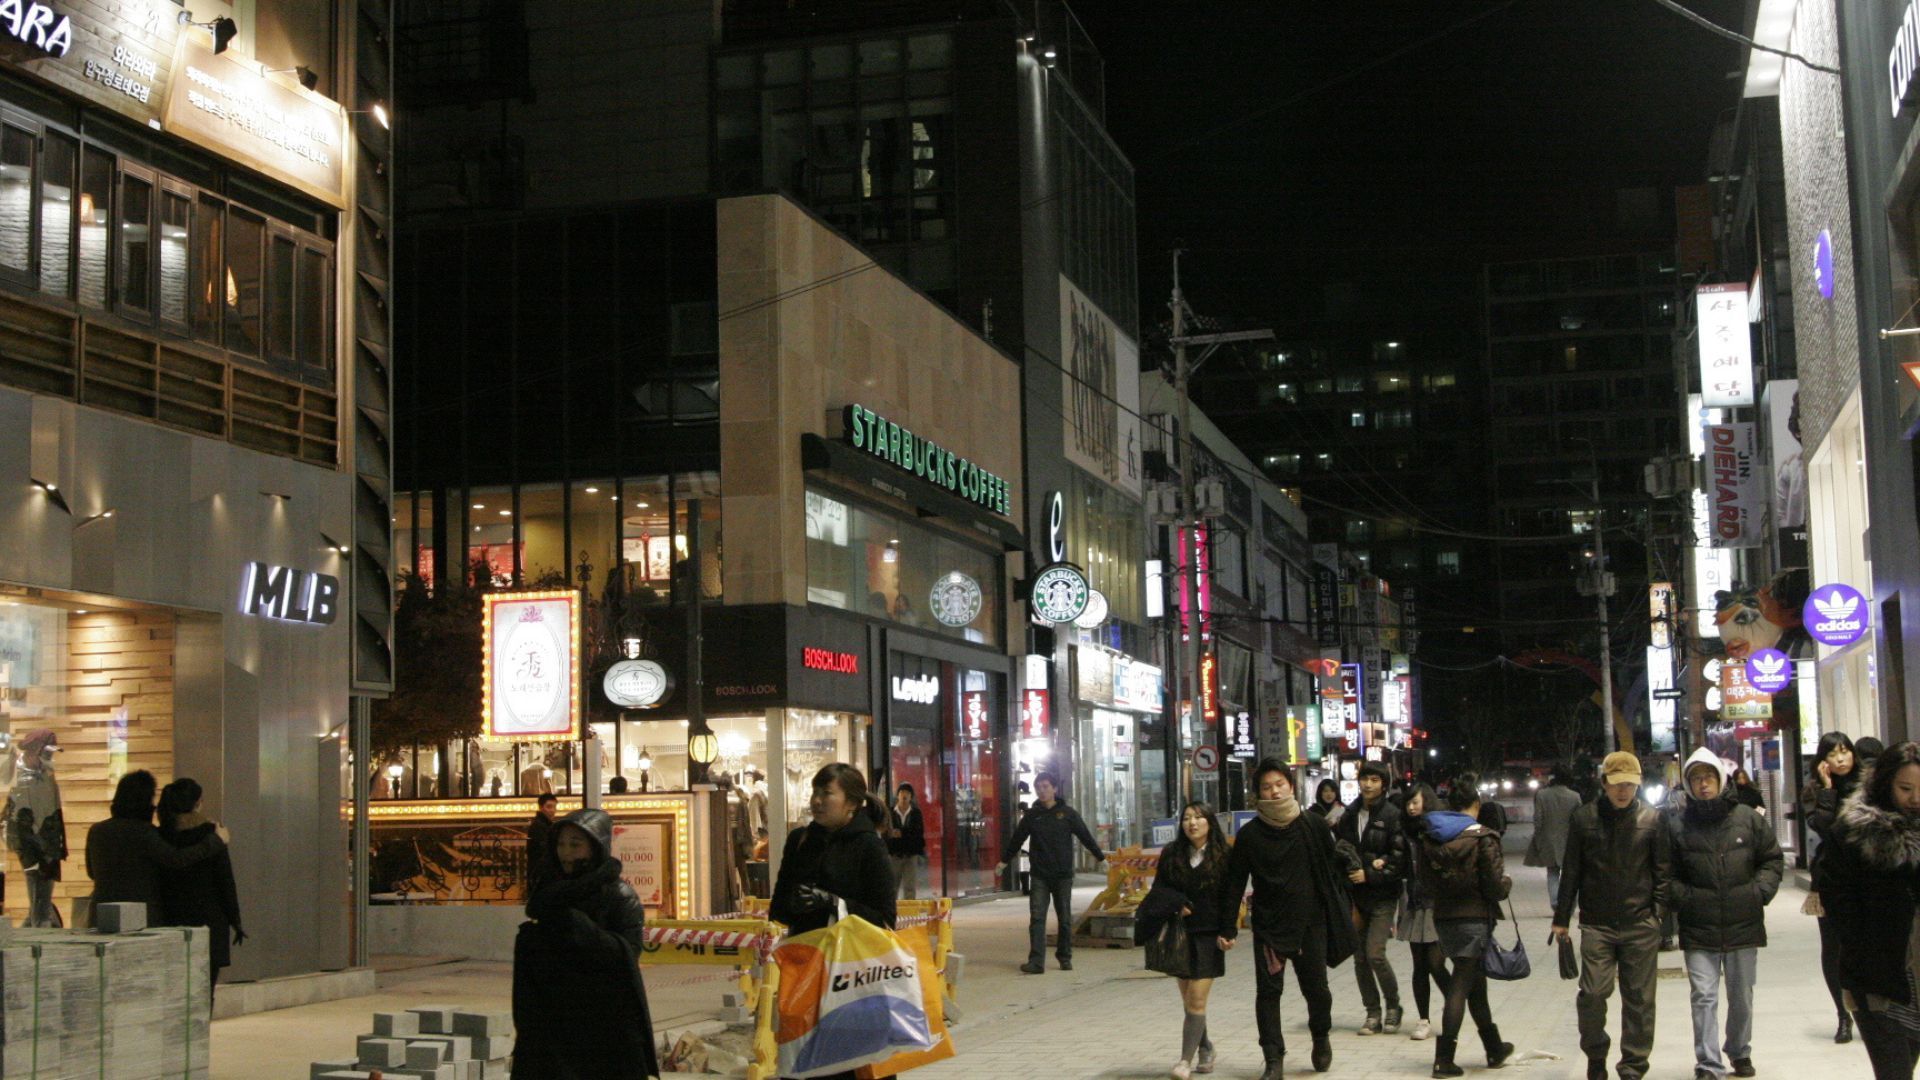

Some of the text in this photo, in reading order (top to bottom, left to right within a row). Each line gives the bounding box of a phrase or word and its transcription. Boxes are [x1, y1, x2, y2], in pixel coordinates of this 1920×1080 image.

[114, 45, 156, 81] 와라와라
[84, 59, 151, 103] 압구정로데오점
[852, 403, 1011, 517] STARBUCKS COFFEE
[1711, 427, 1740, 540] DIEHARD
[243, 562, 339, 625] MLB
[1037, 569, 1084, 594] STARBUCKS
[1042, 605, 1081, 620] COFFEE
[1816, 619, 1860, 632] adidas
[1754, 673, 1785, 682] adidas
[854, 963, 914, 988] killtec
